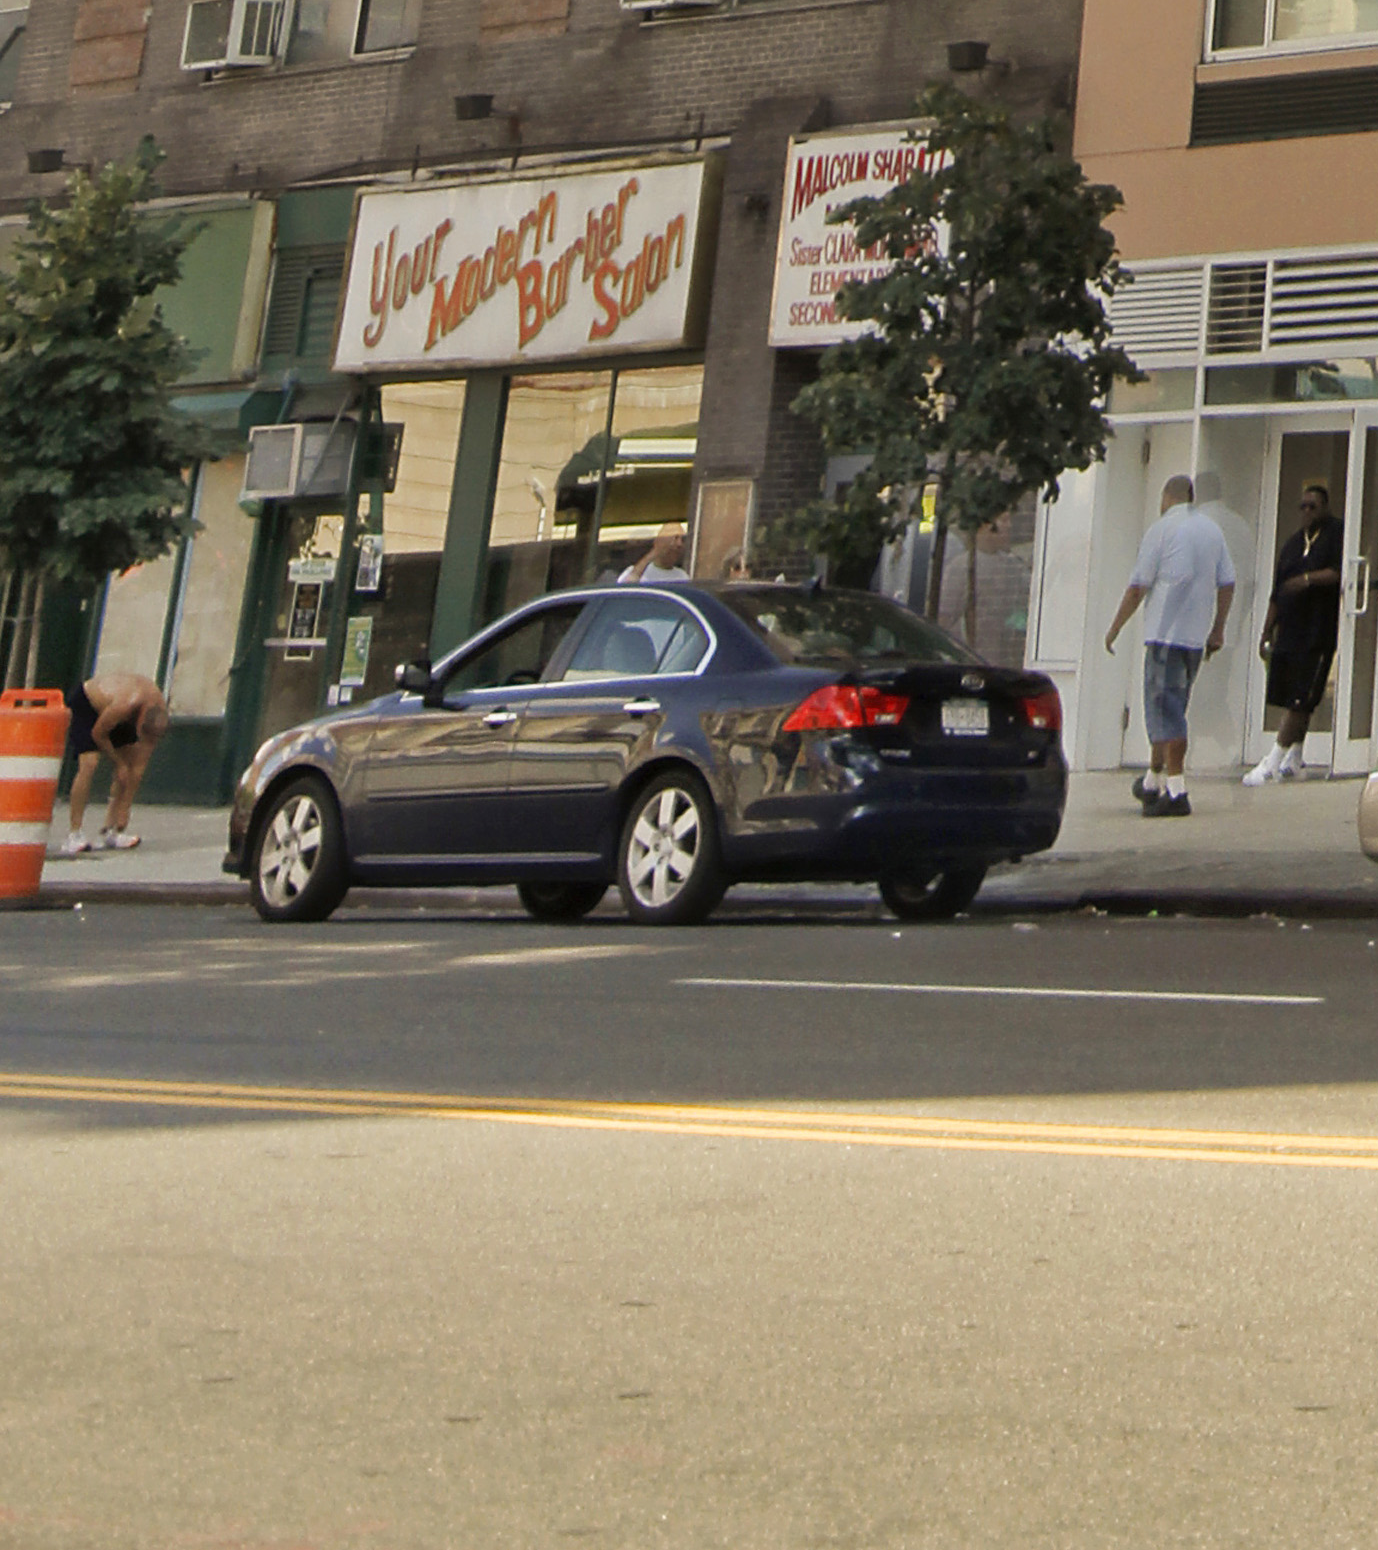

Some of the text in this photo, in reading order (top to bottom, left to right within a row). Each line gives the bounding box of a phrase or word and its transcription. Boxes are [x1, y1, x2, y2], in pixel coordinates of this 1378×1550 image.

[791, 151, 870, 223] MALCOLM
[363, 176, 685, 351] Your Modern Barber Salon
[790, 237, 823, 266] Sister
